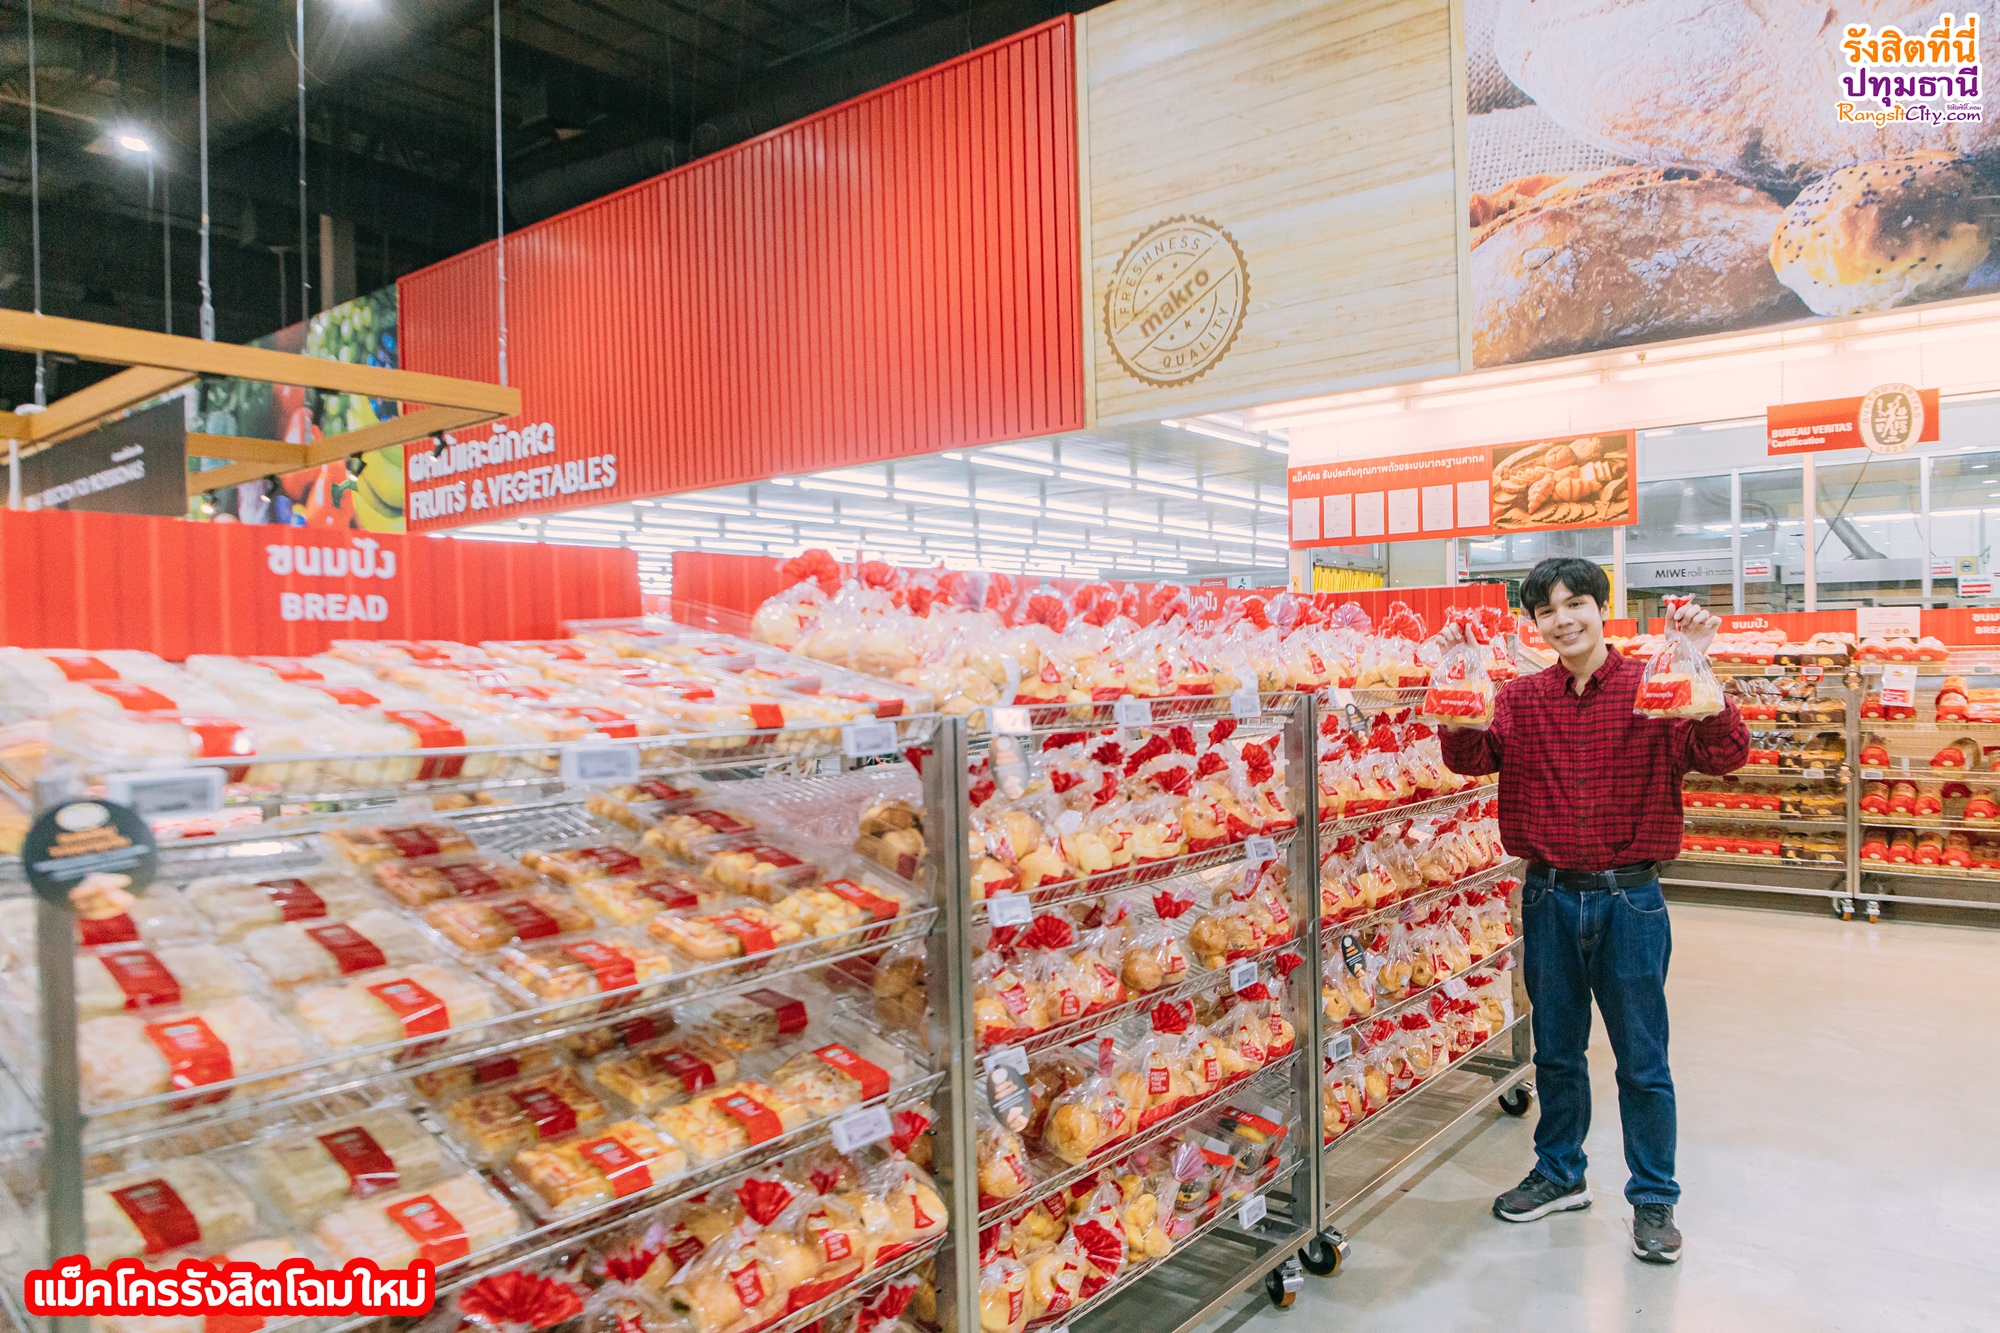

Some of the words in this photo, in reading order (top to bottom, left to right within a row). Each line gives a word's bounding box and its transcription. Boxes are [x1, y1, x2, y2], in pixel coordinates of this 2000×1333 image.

[1119, 236, 1200, 315] FRESHNESS
[1138, 269, 1210, 338] makro
[1162, 306, 1229, 368] QUALITY
[1771, 426, 1810, 438] BUREAU
[1812, 422, 1853, 435] VERITAS
[1771, 436, 1826, 448] Certification
[410, 482, 467, 520] FRUITS
[471, 479, 489, 511] &
[487, 454, 617, 507] VEGETABLES
[265, 537, 396, 579] ขนมปัง
[1655, 568, 1687, 578] MIWE
[280, 592, 389, 622] BREAD
[1731, 617, 1769, 629] ขนมปัง
[1975, 626, 2000, 634] BRE
